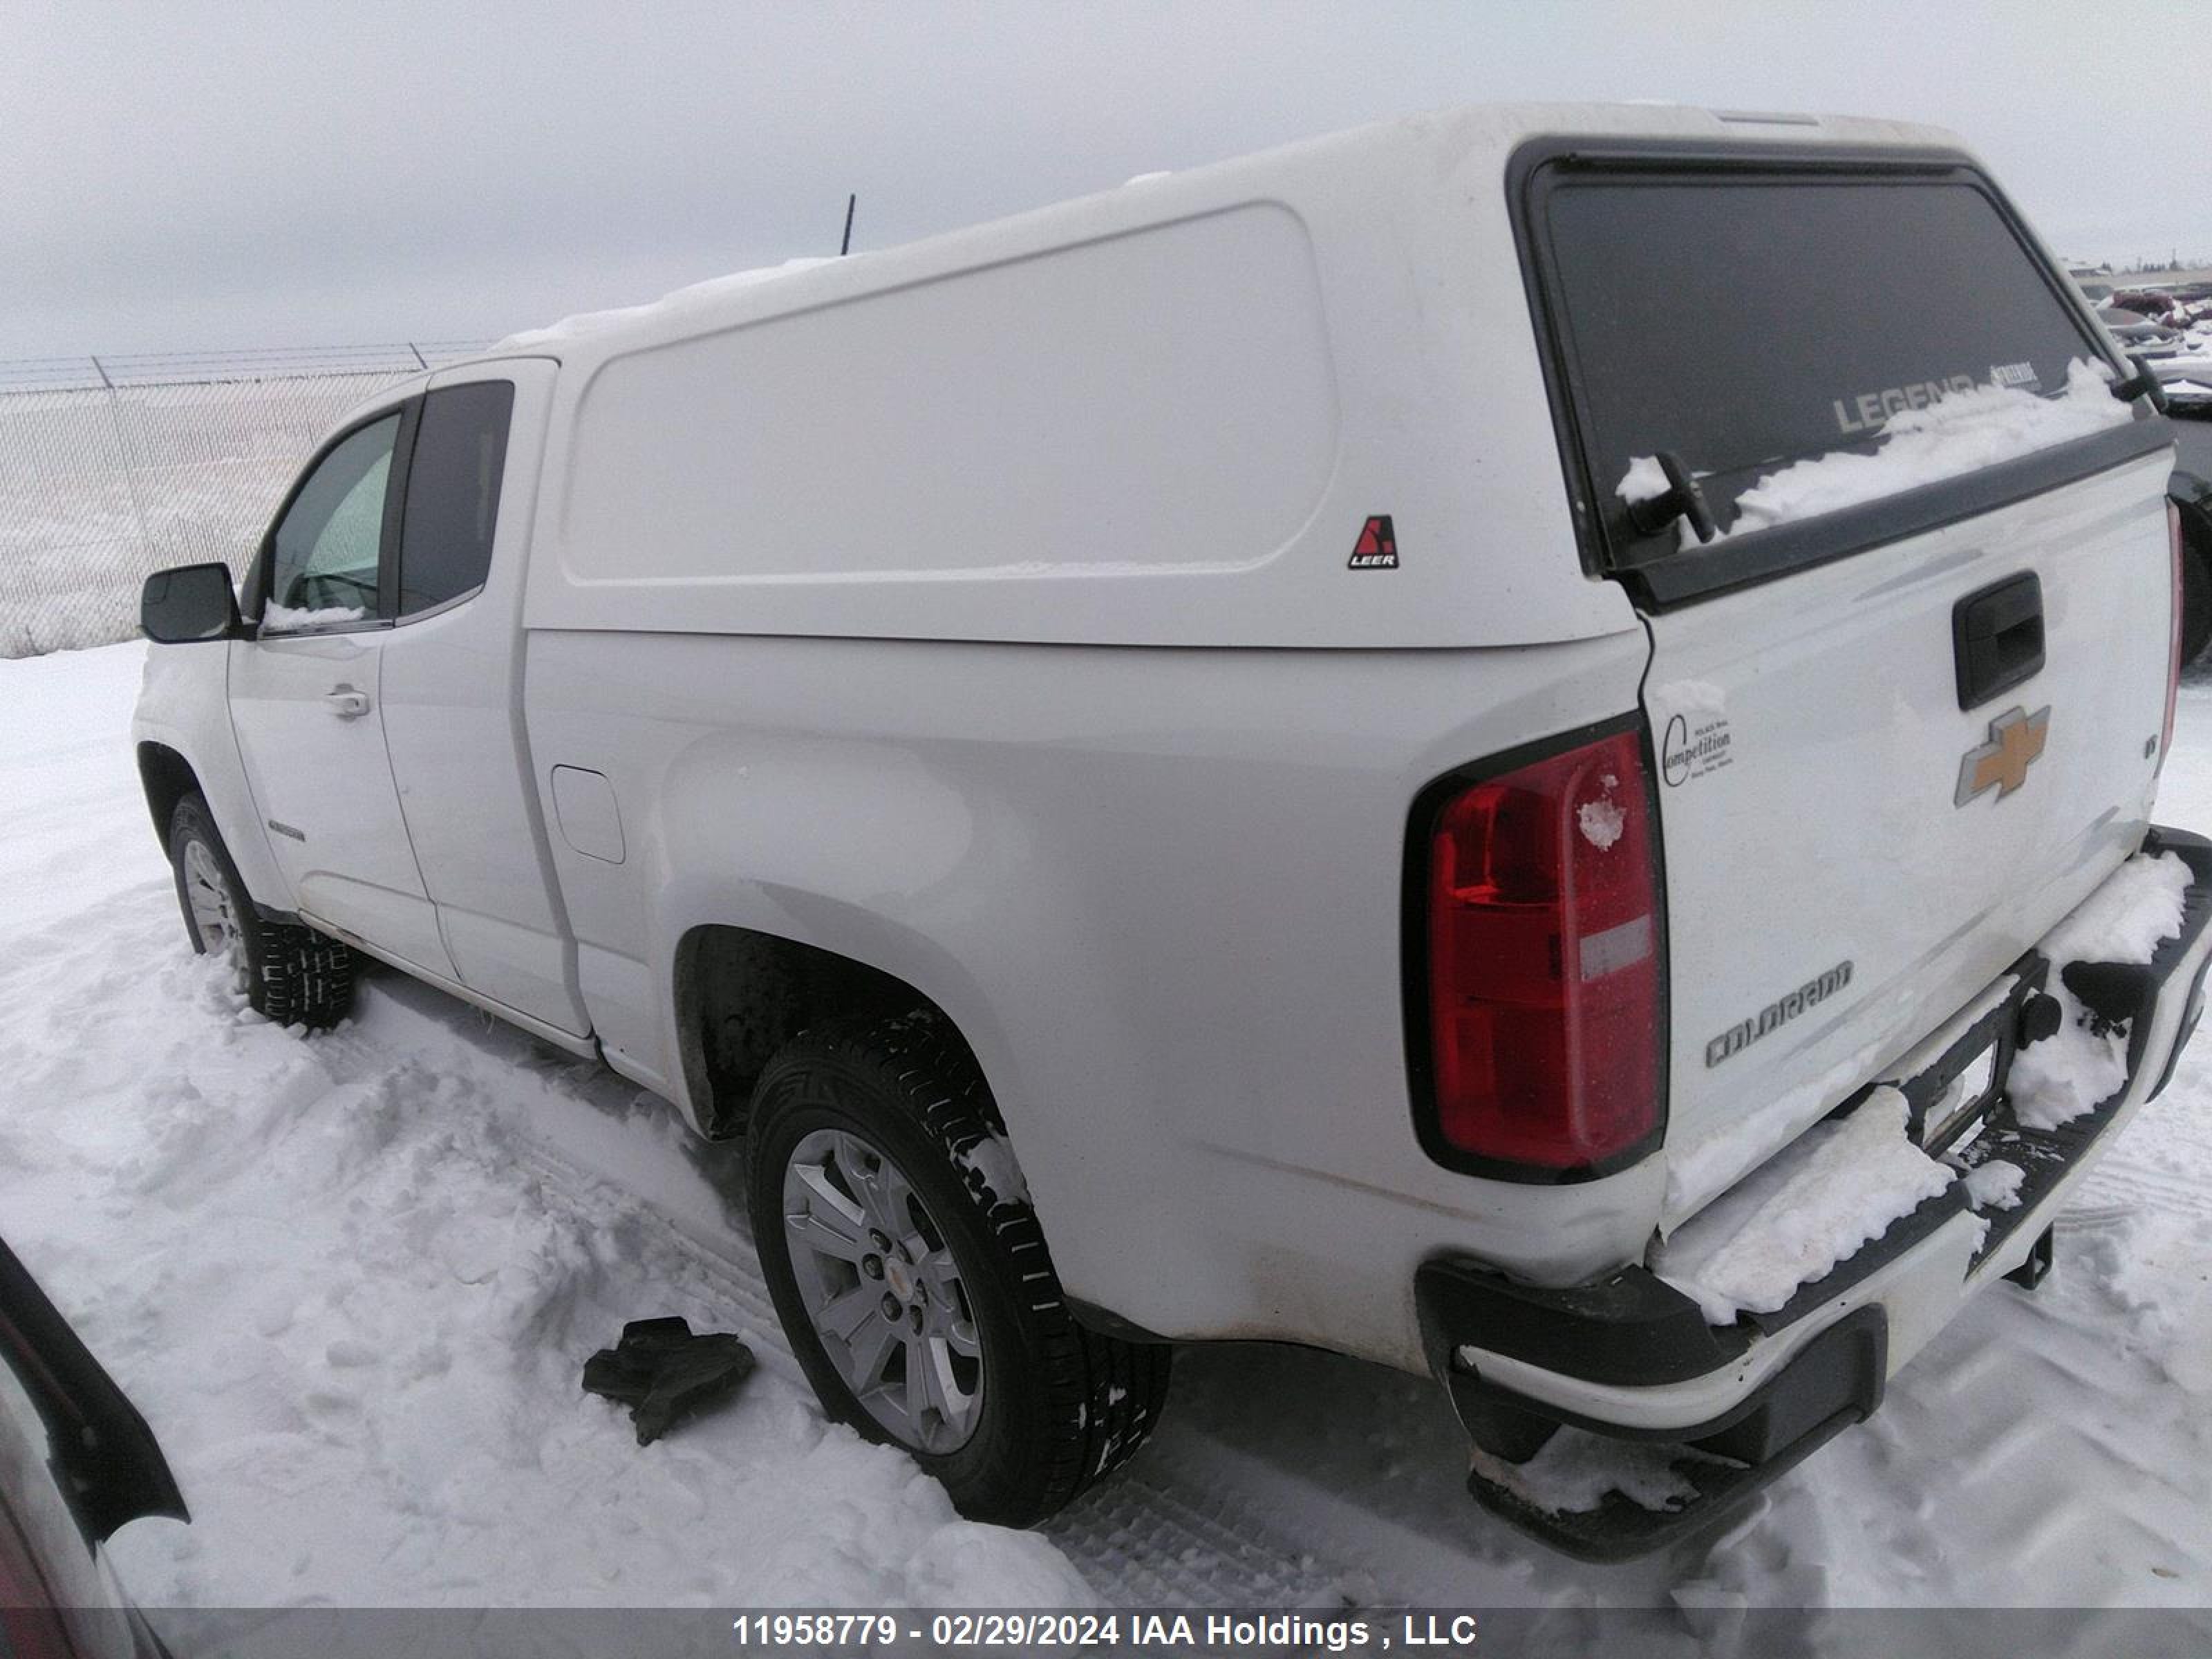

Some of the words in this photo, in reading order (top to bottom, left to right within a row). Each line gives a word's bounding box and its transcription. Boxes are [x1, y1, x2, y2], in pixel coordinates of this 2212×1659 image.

[1351, 554, 1395, 565] LEER
[1662, 714, 1730, 787] Competition
[1705, 959, 1854, 1069] COLORADO
